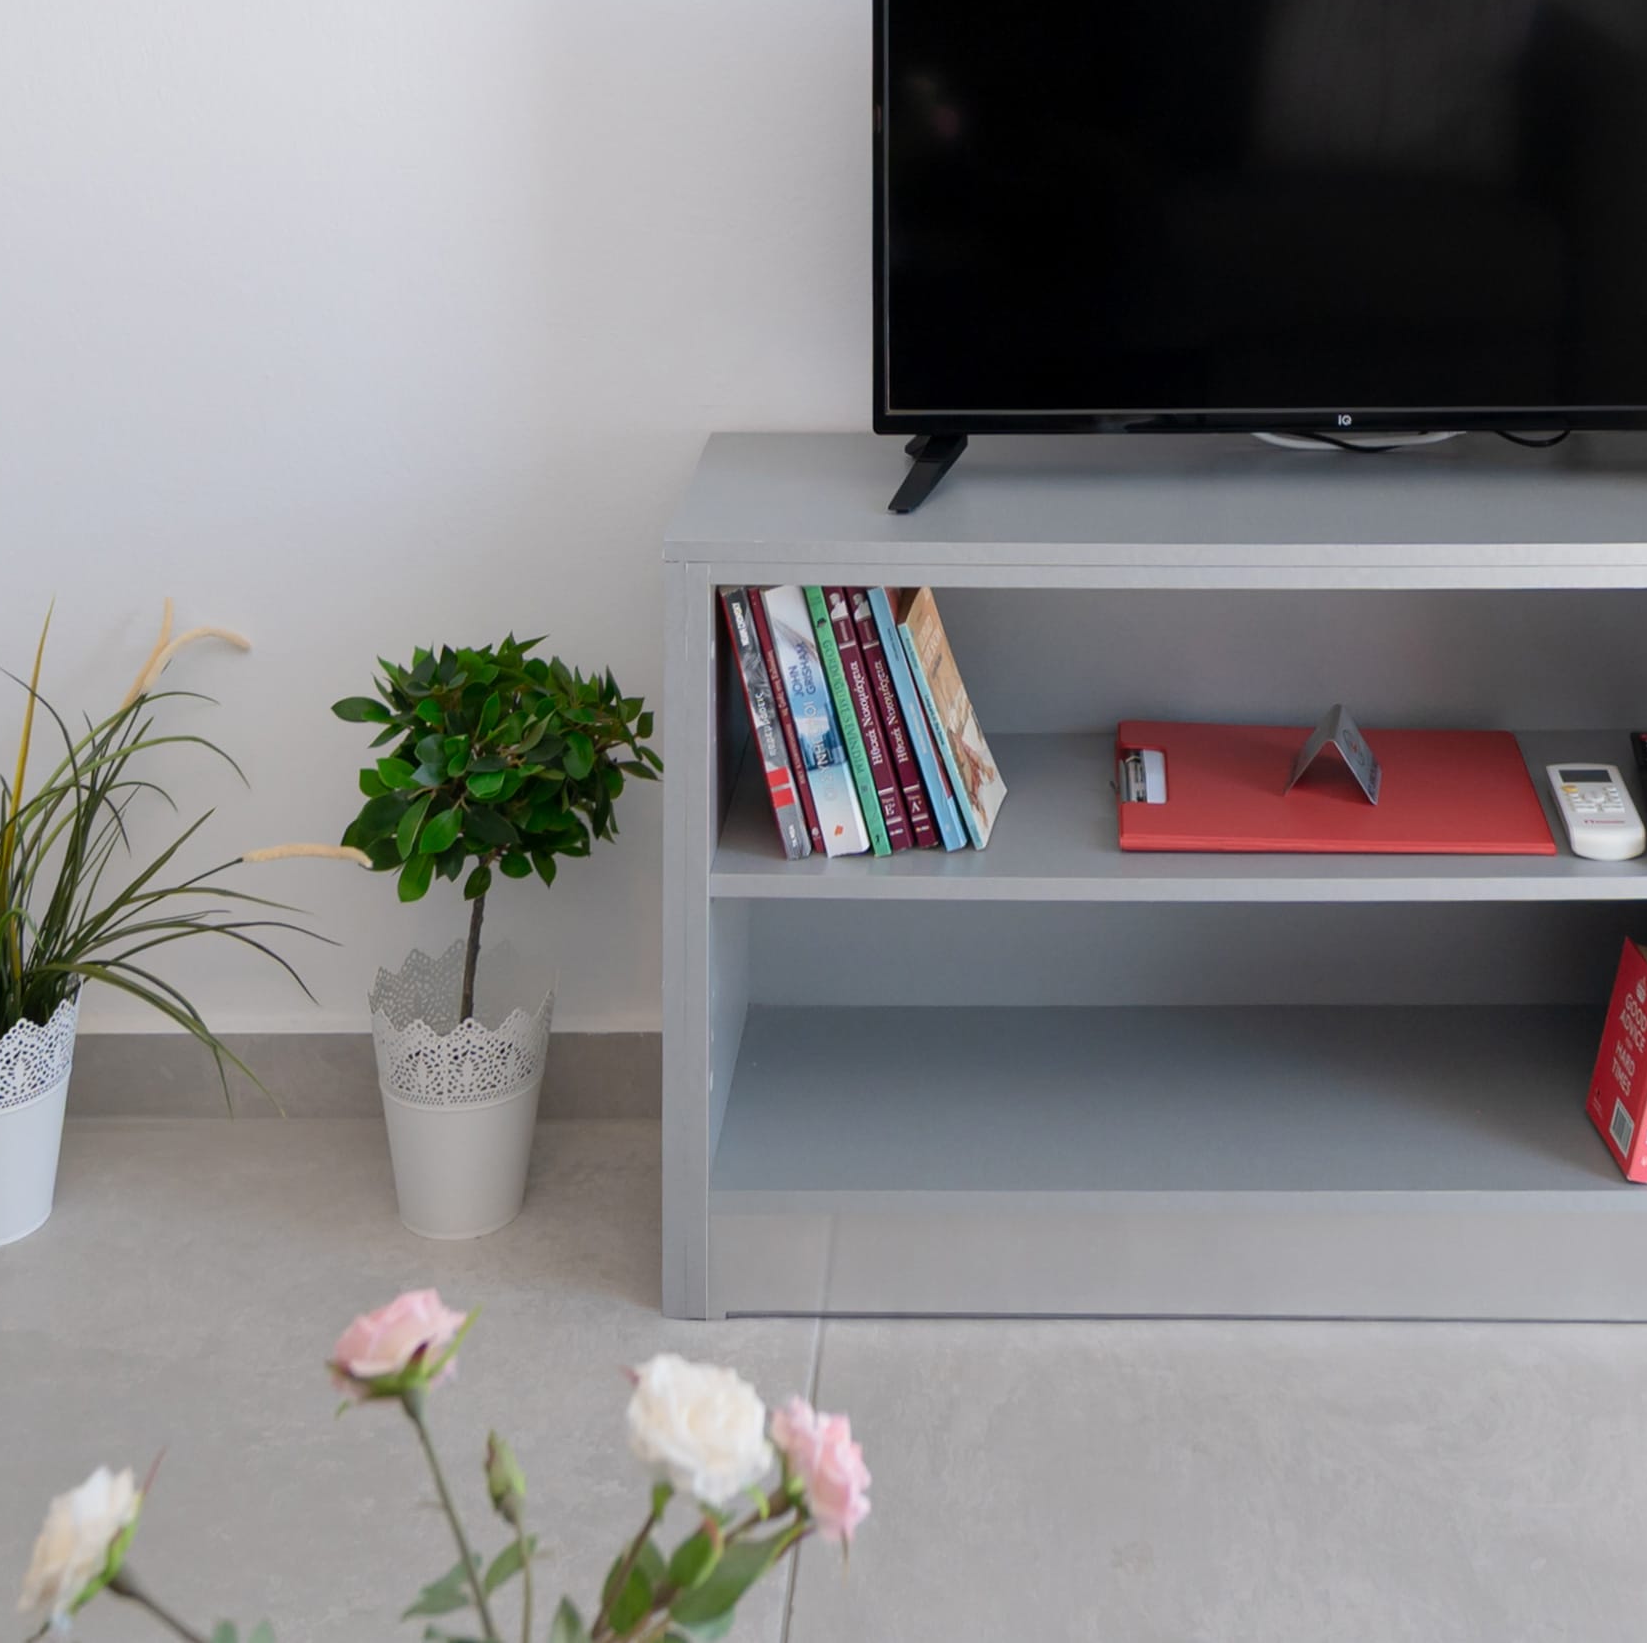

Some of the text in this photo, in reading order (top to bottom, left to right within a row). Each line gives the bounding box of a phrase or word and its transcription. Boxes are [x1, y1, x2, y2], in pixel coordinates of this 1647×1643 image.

[1337, 414, 1352, 426] IQ
[788, 665, 804, 696] JOHN
[796, 641, 816, 695] GRISHAM
[1619, 1010, 1646, 1054] ADVICE
[1625, 993, 1647, 1033] GOOD
[1611, 1057, 1632, 1097] TIMES
[1615, 1040, 1636, 1077] HARD
